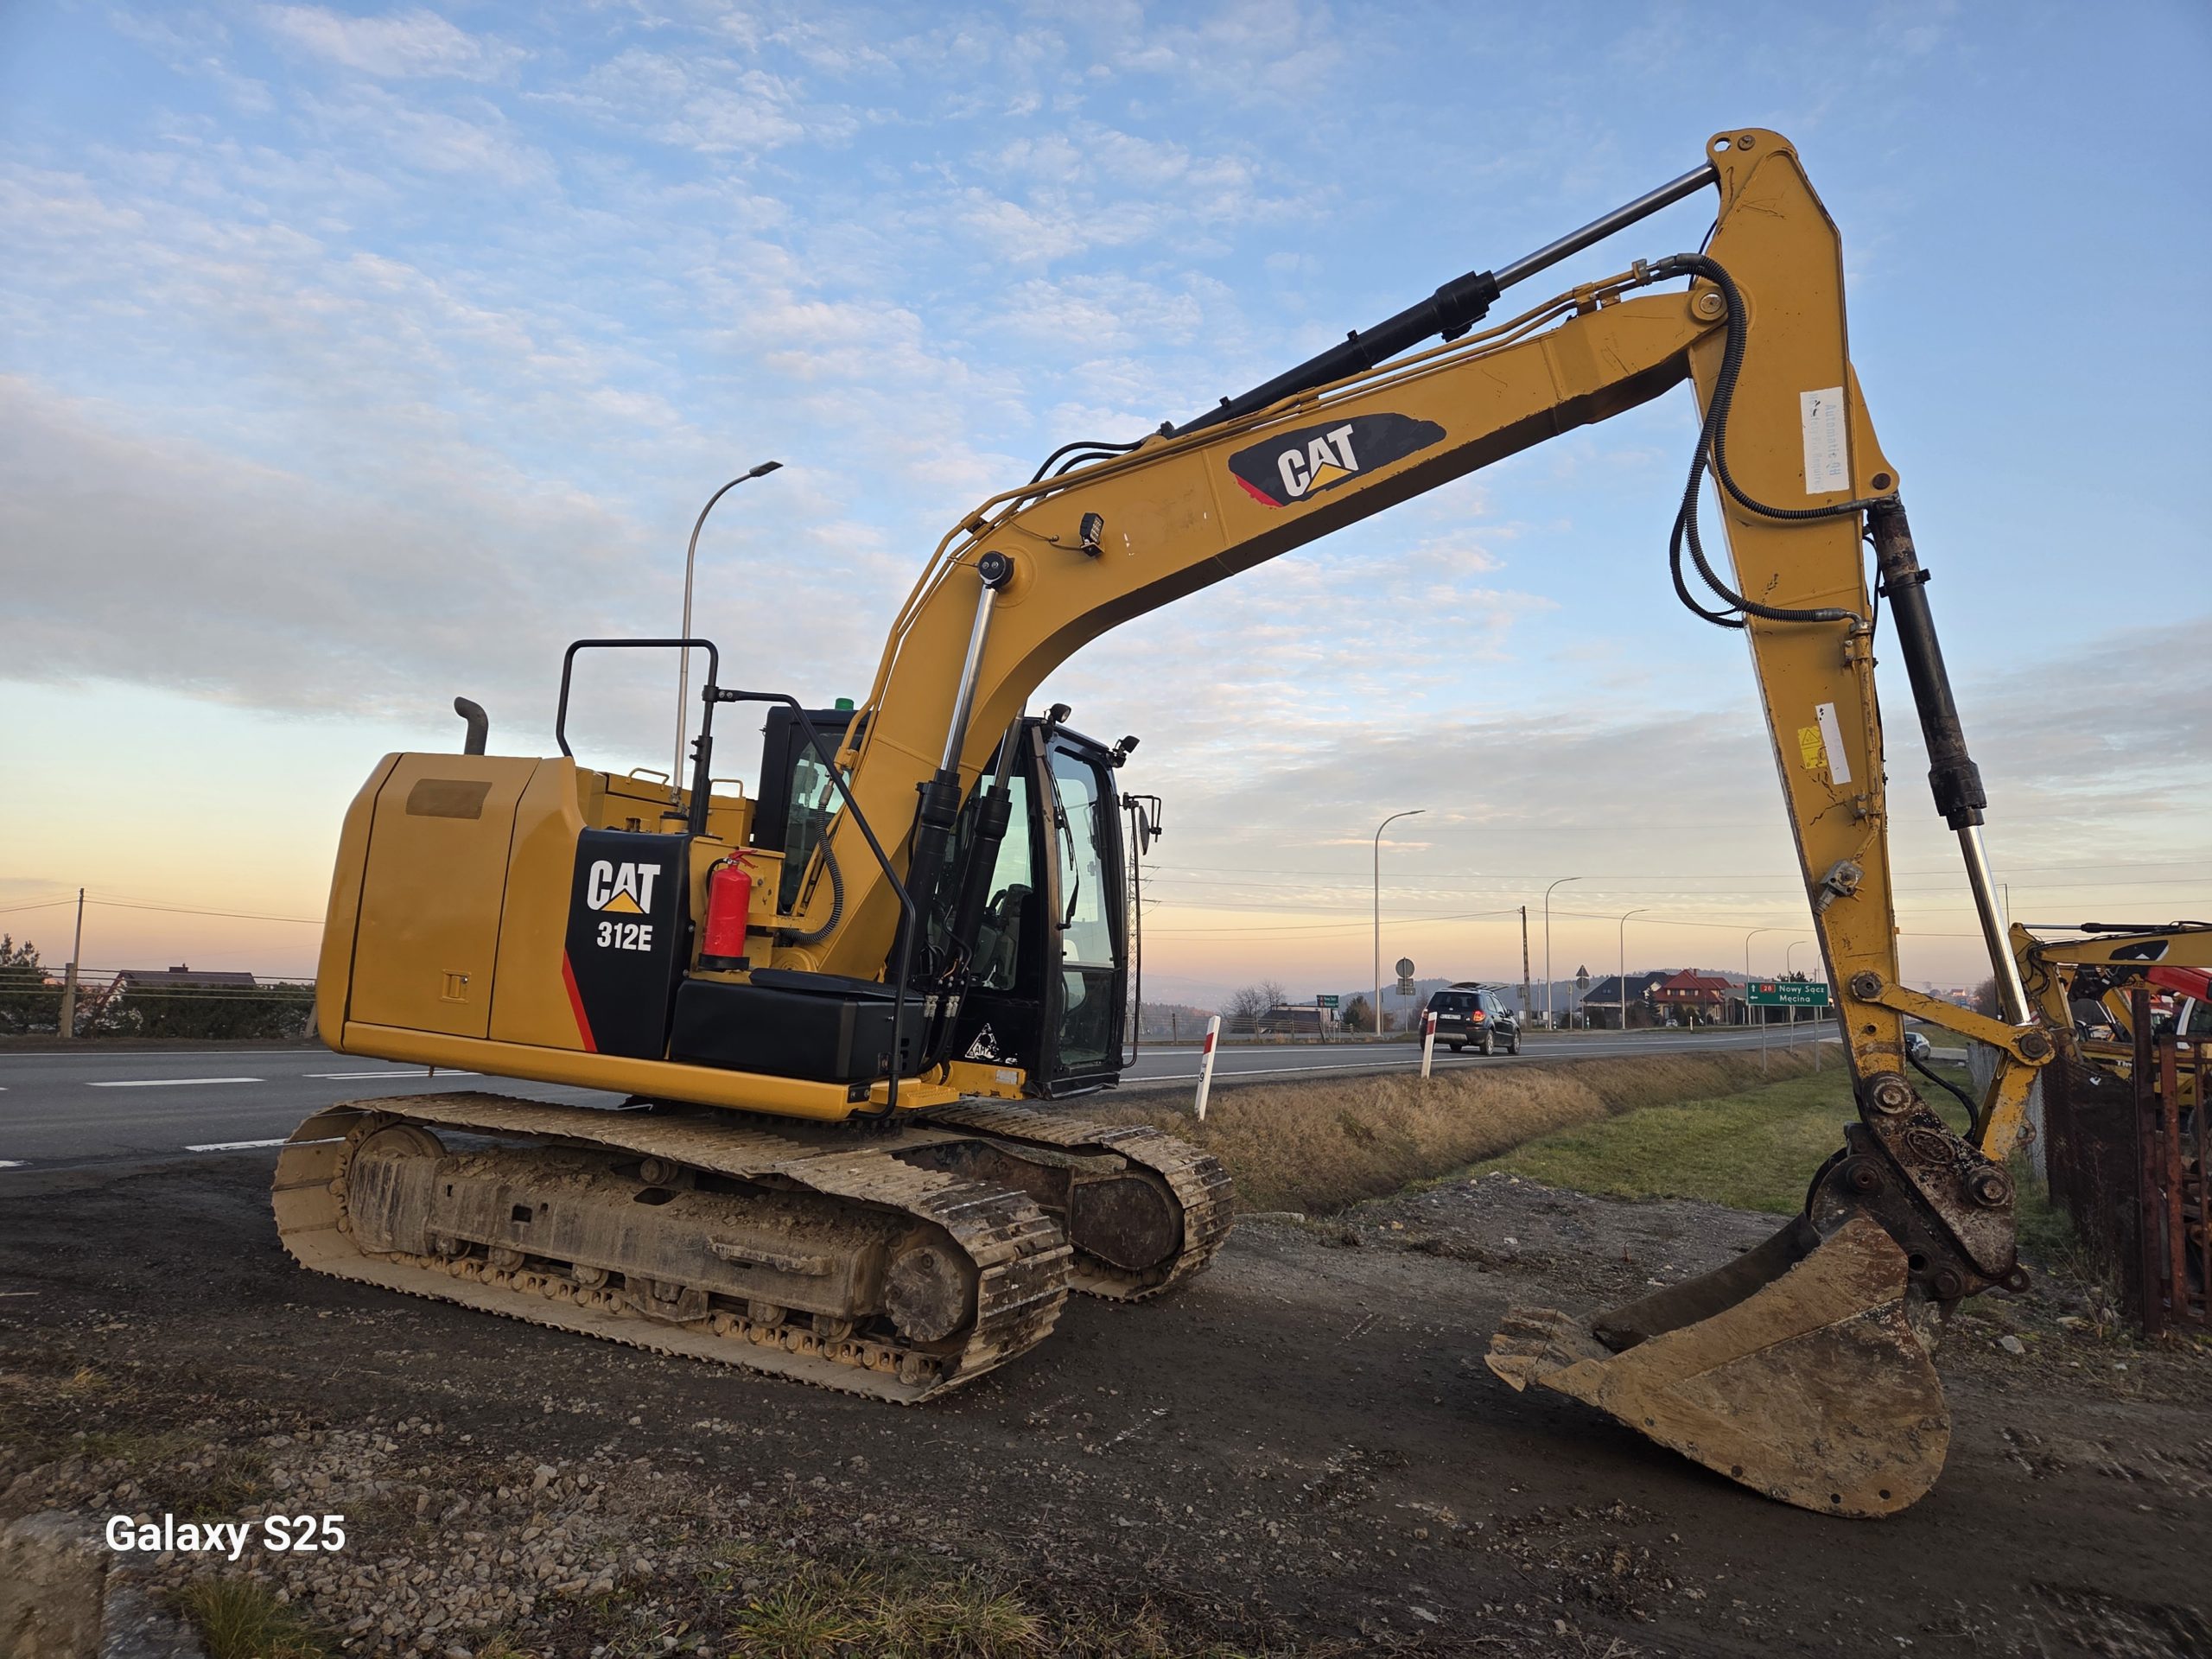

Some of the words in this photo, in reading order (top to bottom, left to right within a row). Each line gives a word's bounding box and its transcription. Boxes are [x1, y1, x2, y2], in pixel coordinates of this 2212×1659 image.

[1824, 404, 1840, 459] Automatic
[1277, 423, 1359, 497] CAT
[587, 860, 661, 914] CAT
[596, 921, 653, 952] 312E
[1779, 985, 1802, 994] Nowy
[1804, 985, 1825, 994] Sącz
[1779, 994, 1811, 1003] Męcina
